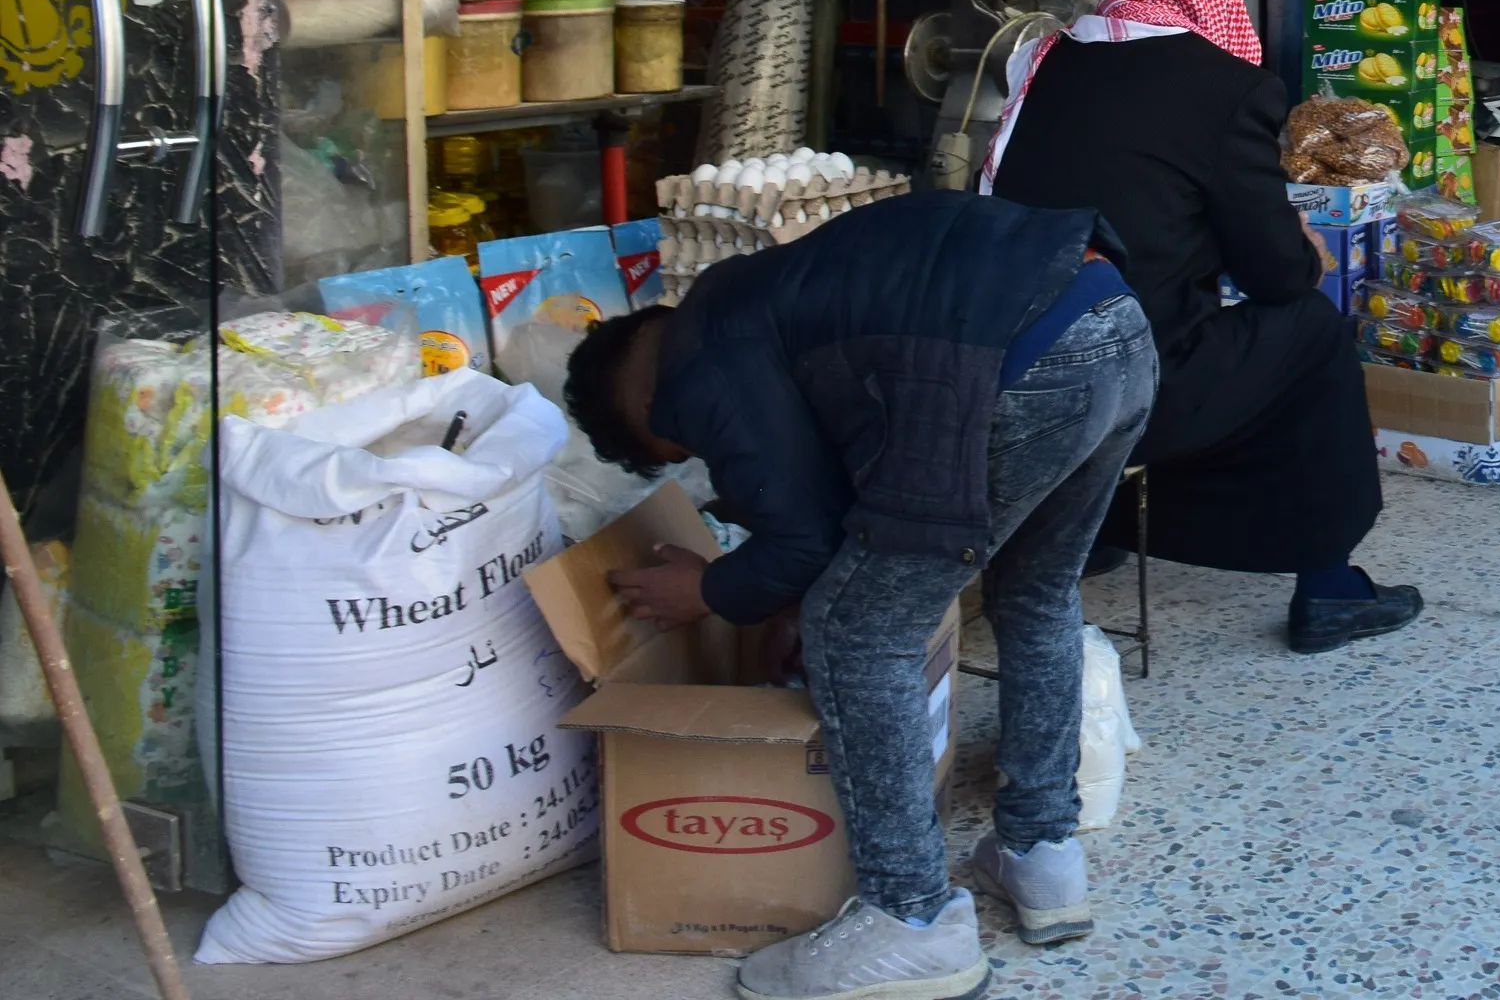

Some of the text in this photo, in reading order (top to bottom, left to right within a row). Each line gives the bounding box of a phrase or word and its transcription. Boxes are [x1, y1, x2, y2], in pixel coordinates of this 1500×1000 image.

[1313, 0, 1364, 19] Mito
[1311, 49, 1363, 69] Mito
[628, 257, 650, 280] NEW
[488, 282, 517, 306] NEW
[325, 530, 545, 634] Wheat Flour
[447, 733, 551, 799] 50 kg
[326, 839, 443, 867] Product
[449, 819, 513, 852] Date
[663, 808, 789, 844] tayaş
[333, 880, 431, 910] Expiry
[441, 860, 500, 892] Date
